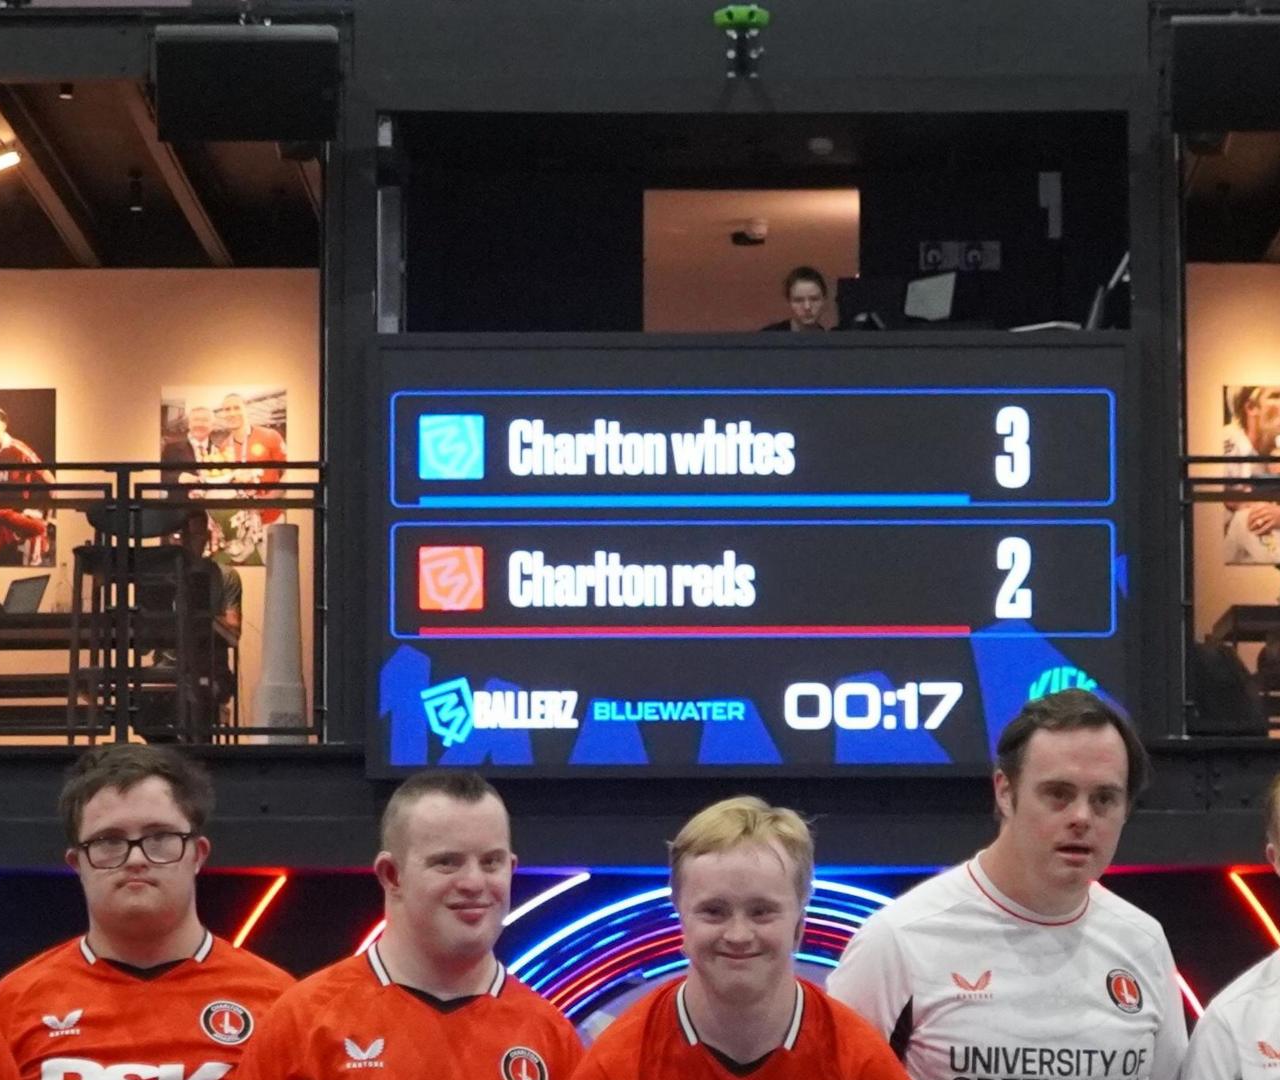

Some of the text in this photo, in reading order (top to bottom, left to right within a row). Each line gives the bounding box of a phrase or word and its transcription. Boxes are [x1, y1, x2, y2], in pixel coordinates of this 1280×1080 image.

[508, 418, 796, 476] Charlton whites
[994, 406, 1031, 488] 3
[508, 550, 756, 608] Charlton reds
[994, 536, 1032, 619] 2
[472, 690, 579, 729] BALLERZ
[593, 701, 745, 721] BLUEWATER
[784, 682, 963, 730] 00:17
[950, 1046, 1147, 1076] UNIVERSITY OF
